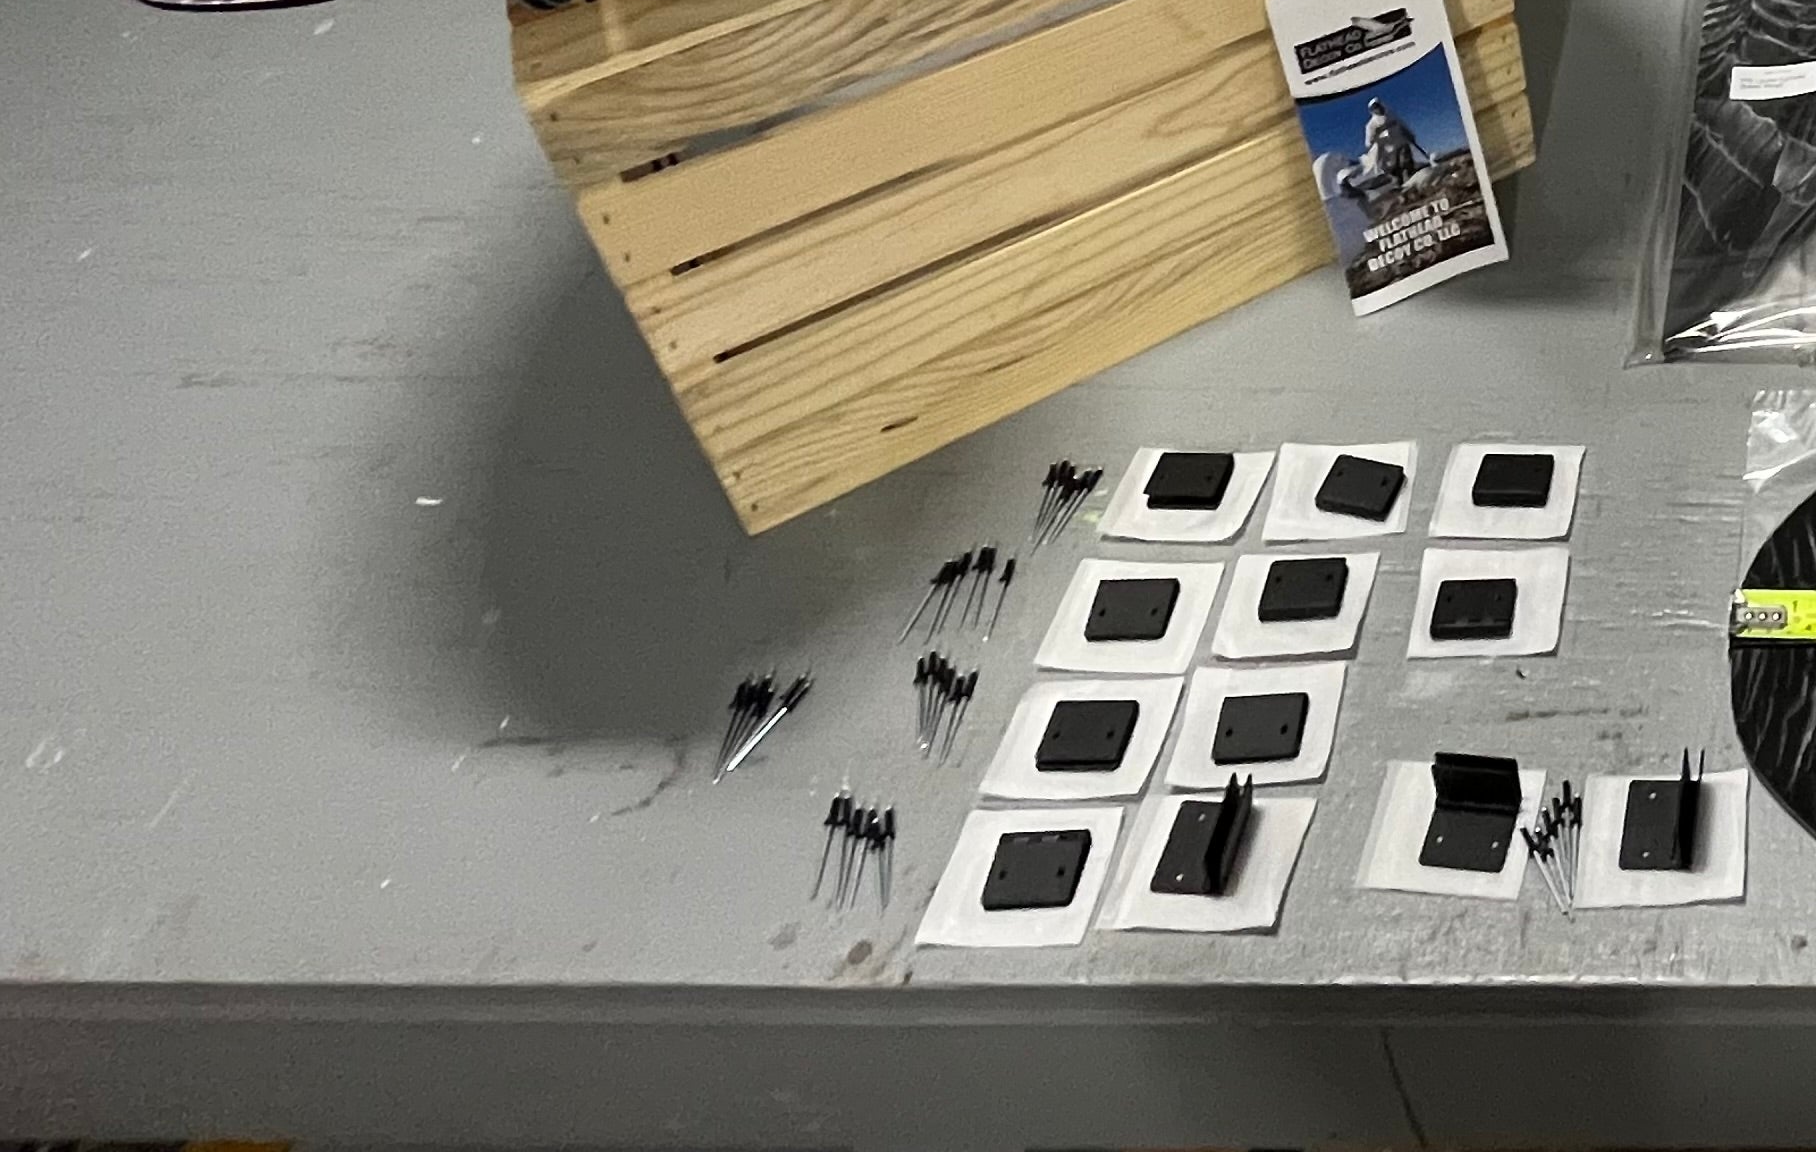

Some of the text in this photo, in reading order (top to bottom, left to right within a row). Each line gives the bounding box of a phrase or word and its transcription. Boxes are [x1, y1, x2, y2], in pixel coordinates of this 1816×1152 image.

[1363, 198, 1449, 243] WELCOME TO
[1379, 214, 1443, 252] FLATHEAD
[1367, 243, 1411, 271] DECOY
[1792, 600, 1799, 613] 1
